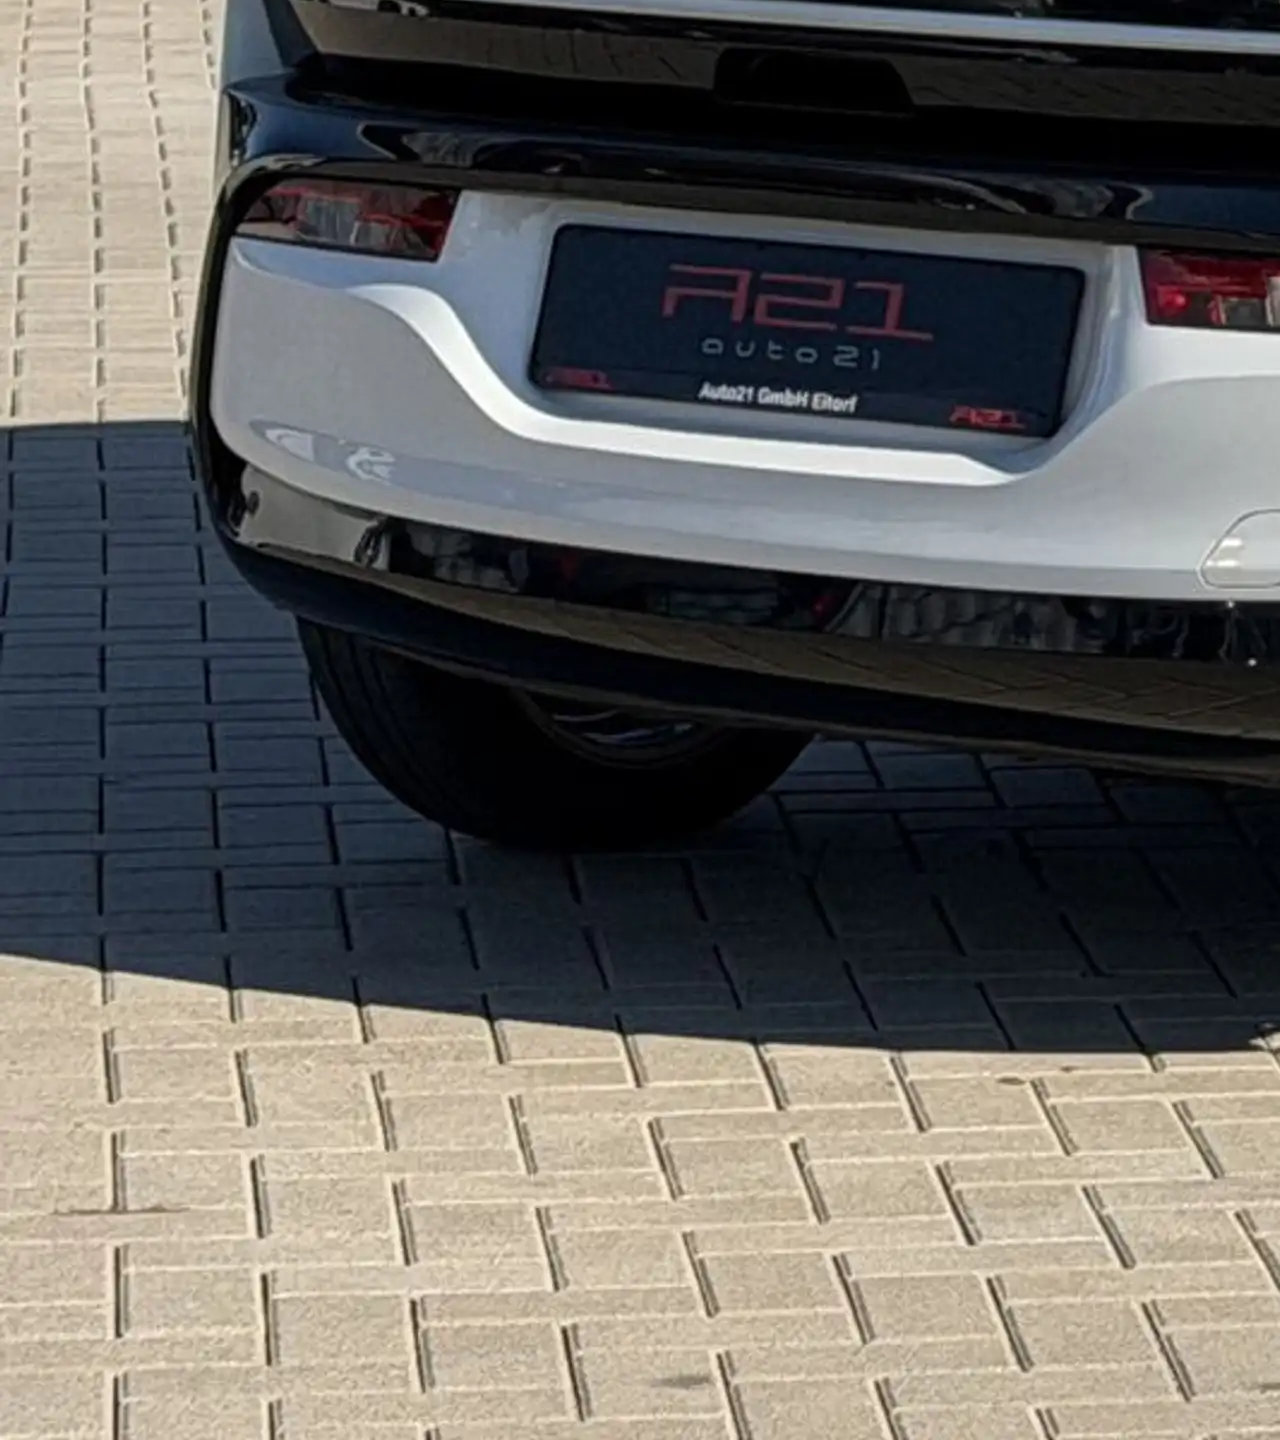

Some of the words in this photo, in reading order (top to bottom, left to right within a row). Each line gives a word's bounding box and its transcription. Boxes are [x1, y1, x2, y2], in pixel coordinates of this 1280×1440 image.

[661, 263, 935, 342] A21
[698, 380, 755, 405] Auto21
[757, 386, 810, 410] GmbH
